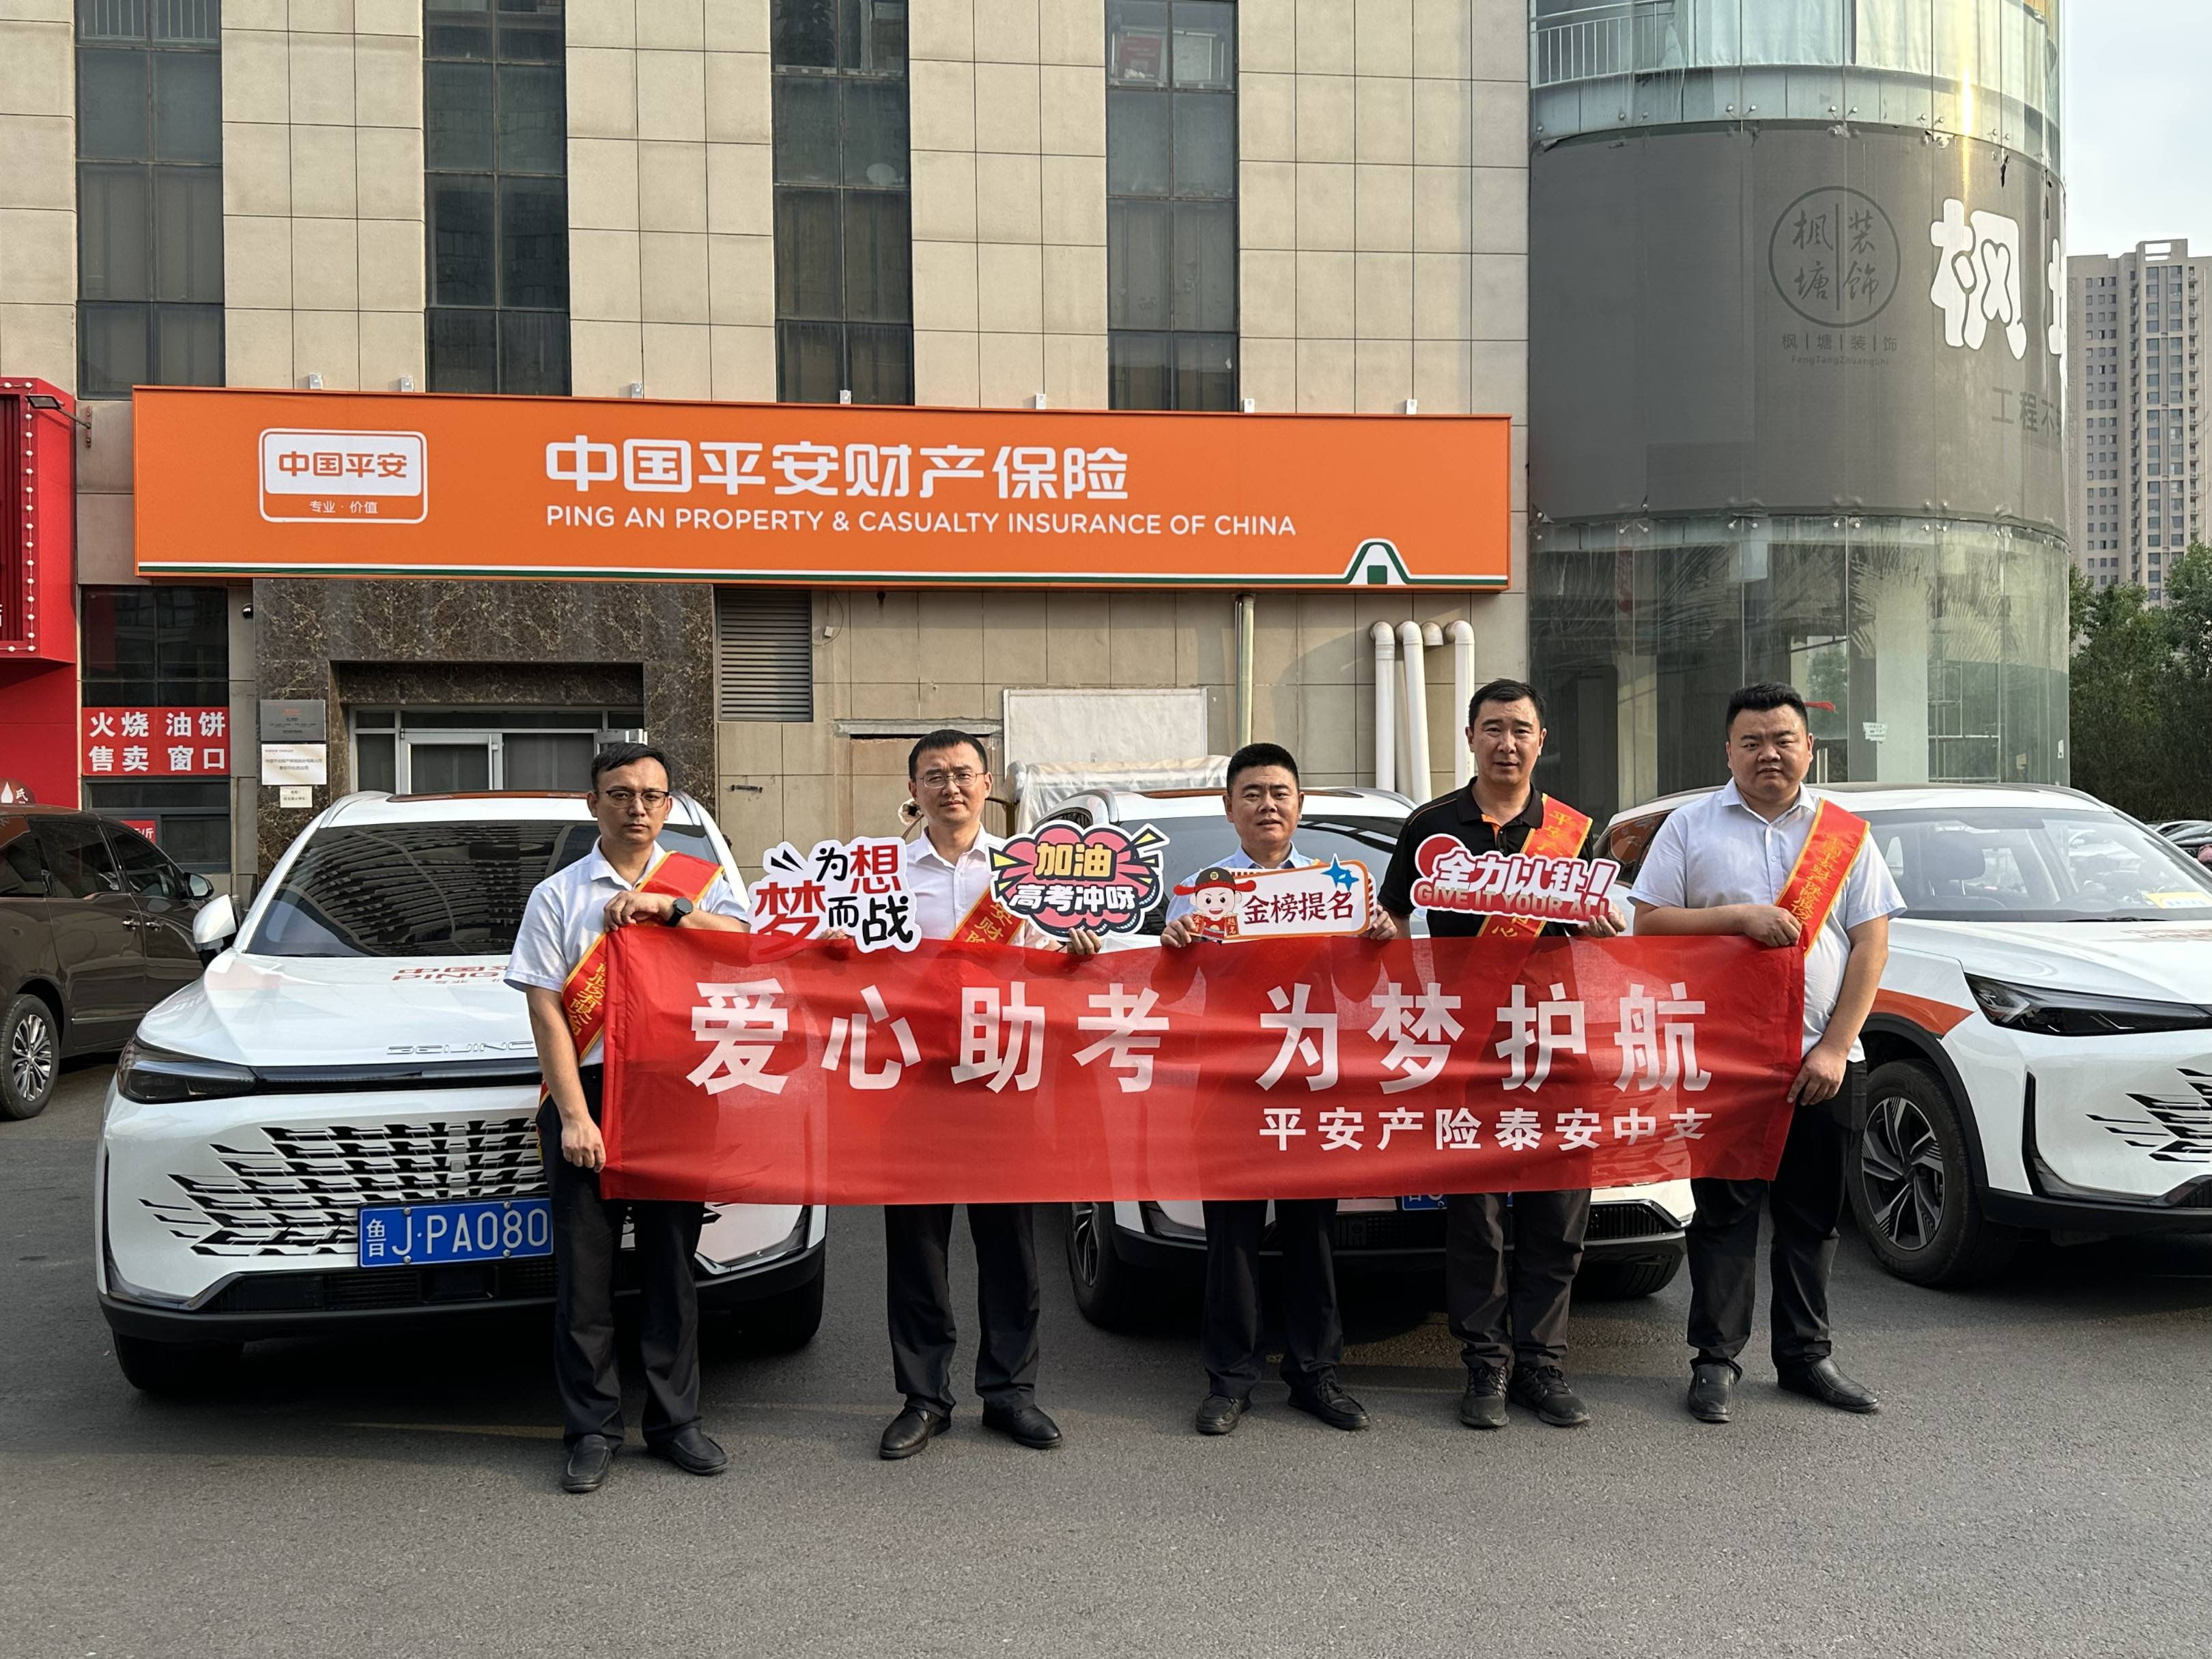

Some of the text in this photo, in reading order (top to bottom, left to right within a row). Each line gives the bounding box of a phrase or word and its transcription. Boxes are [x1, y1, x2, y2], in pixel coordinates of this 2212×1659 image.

[279, 451, 407, 478] 中国平安
[545, 434, 1129, 500] 中国平安财产保险
[547, 505, 1296, 537] PING AN PROPERTY & CASUALTY INSURANCE OF CHINA
[89, 711, 226, 738] 火烧 油饼
[89, 744, 225, 772] 售卖 窗口
[1034, 841, 1115, 880] 加油
[1008, 882, 1138, 913] 高考冲呀
[1243, 890, 1354, 925] 金榜提名
[1417, 884, 1470, 905] GIVE
[1475, 890, 1497, 909] IT
[1502, 892, 1563, 916] YOUR
[686, 978, 1713, 1096] 爱心助考 为梦护航
[1258, 1106, 1714, 1152] 平安产险泰安中支
